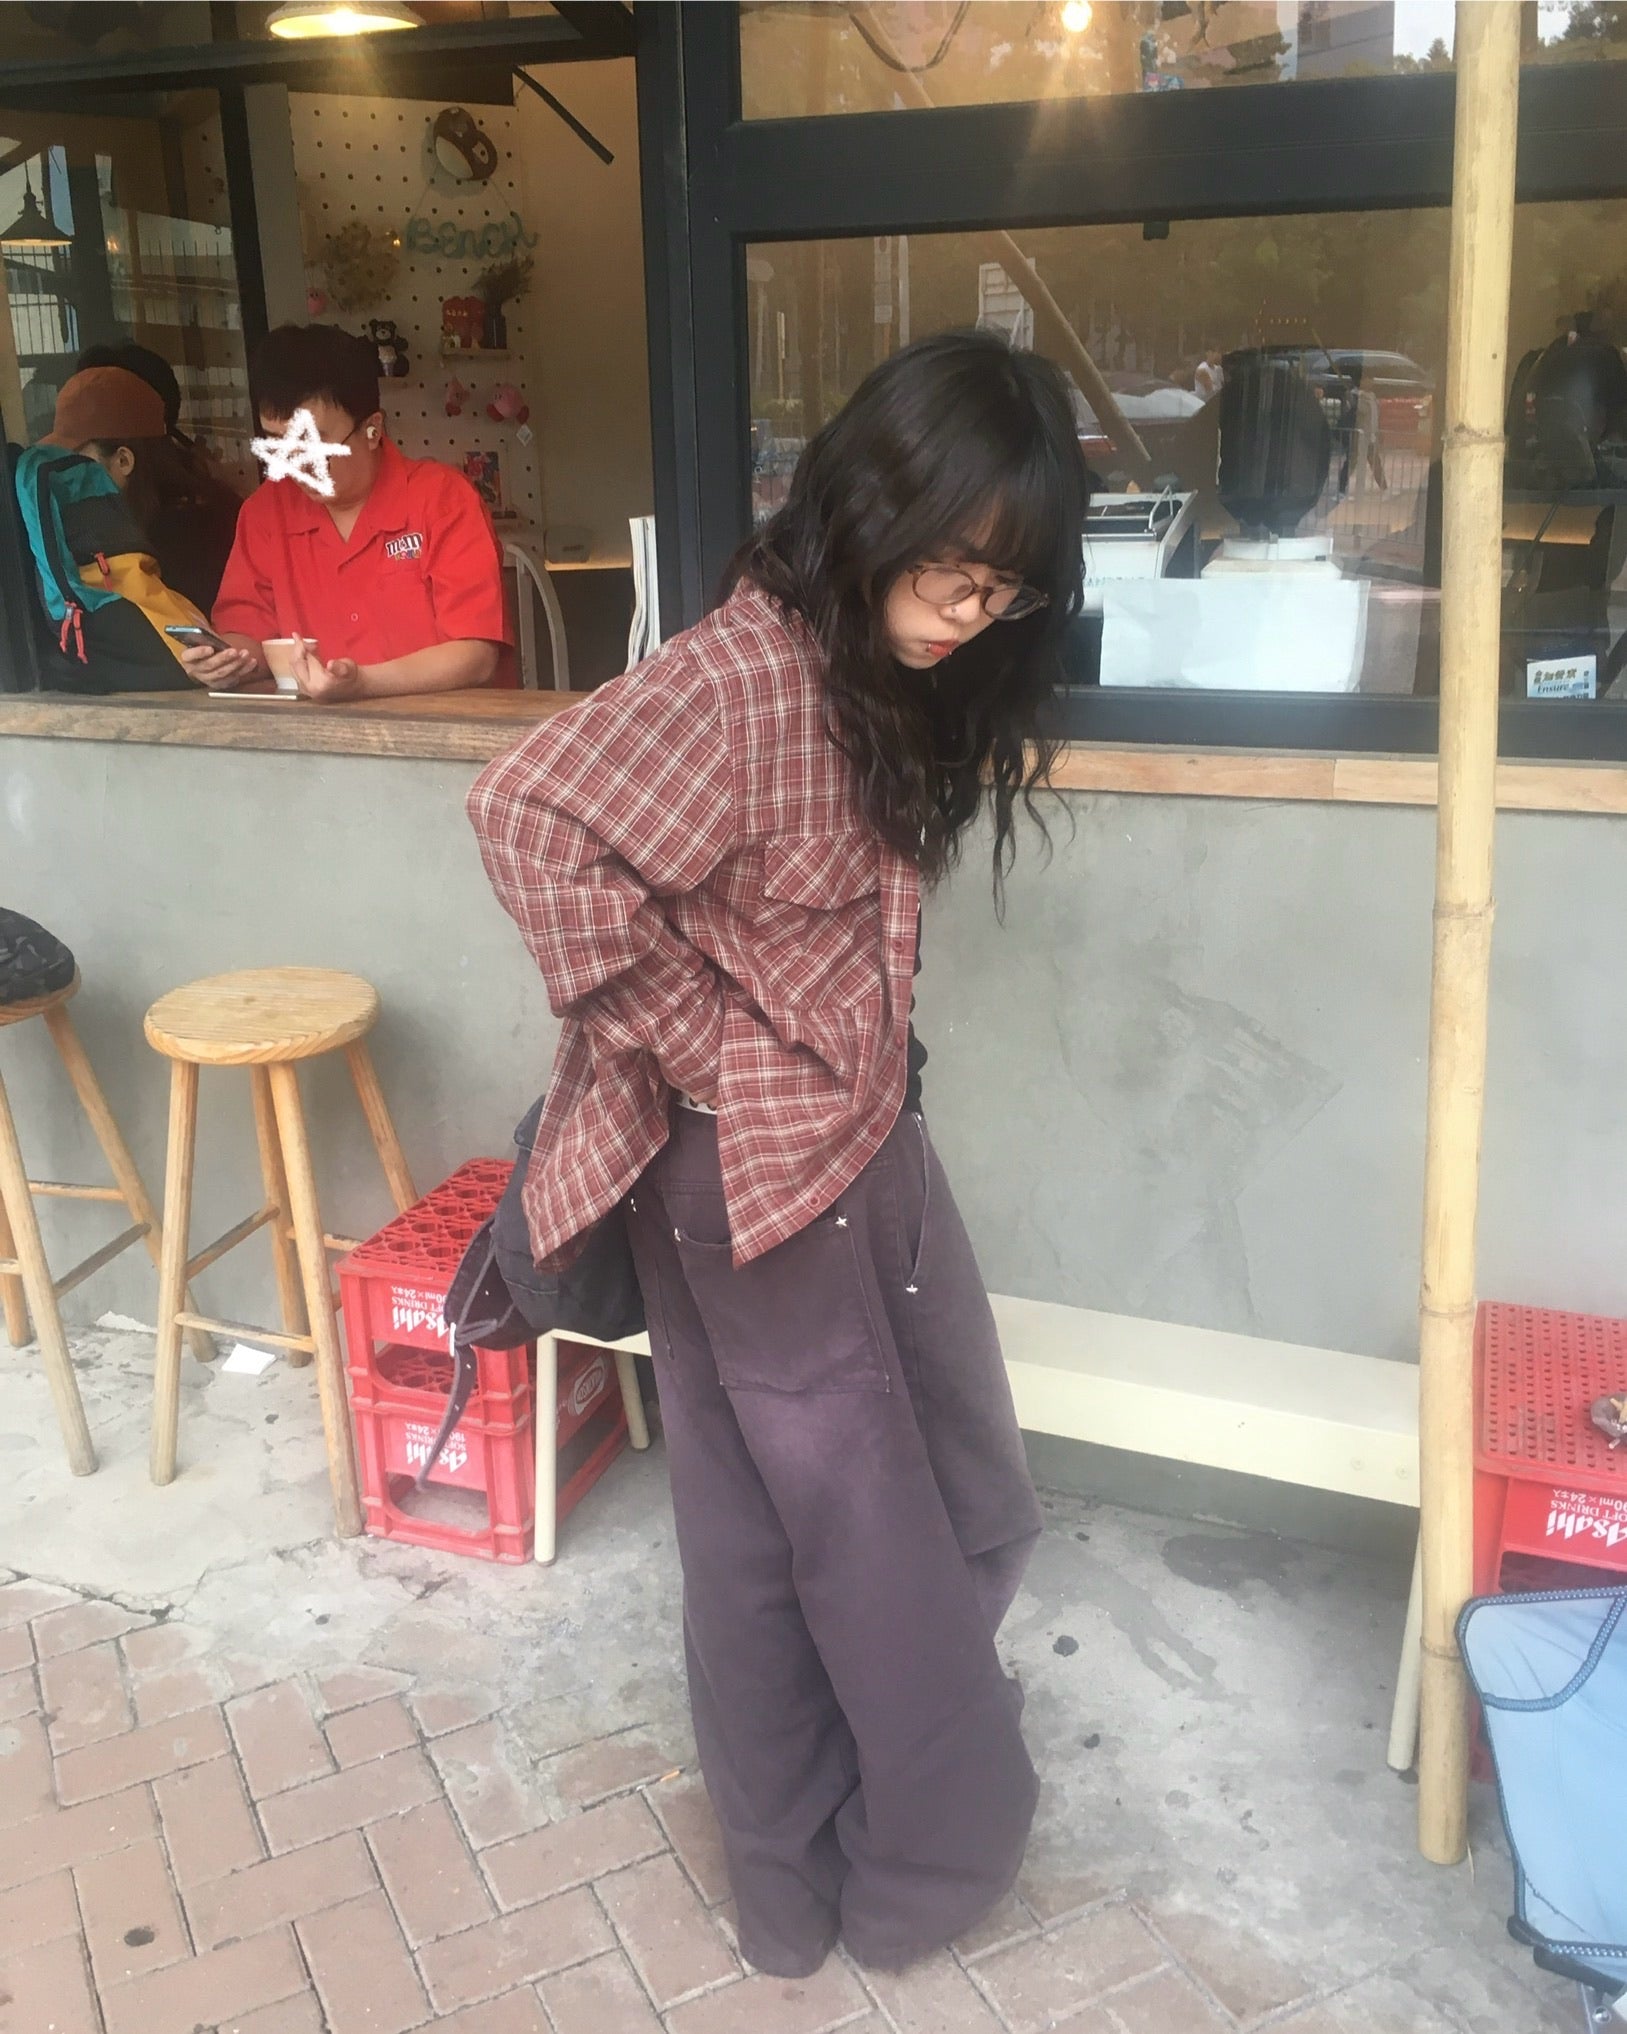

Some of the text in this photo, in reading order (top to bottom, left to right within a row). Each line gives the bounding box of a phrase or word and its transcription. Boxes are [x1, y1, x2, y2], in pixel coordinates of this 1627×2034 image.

[1551, 1500, 1627, 1523] OFT DRINKS
[1546, 1510, 1627, 1548] Asahi
